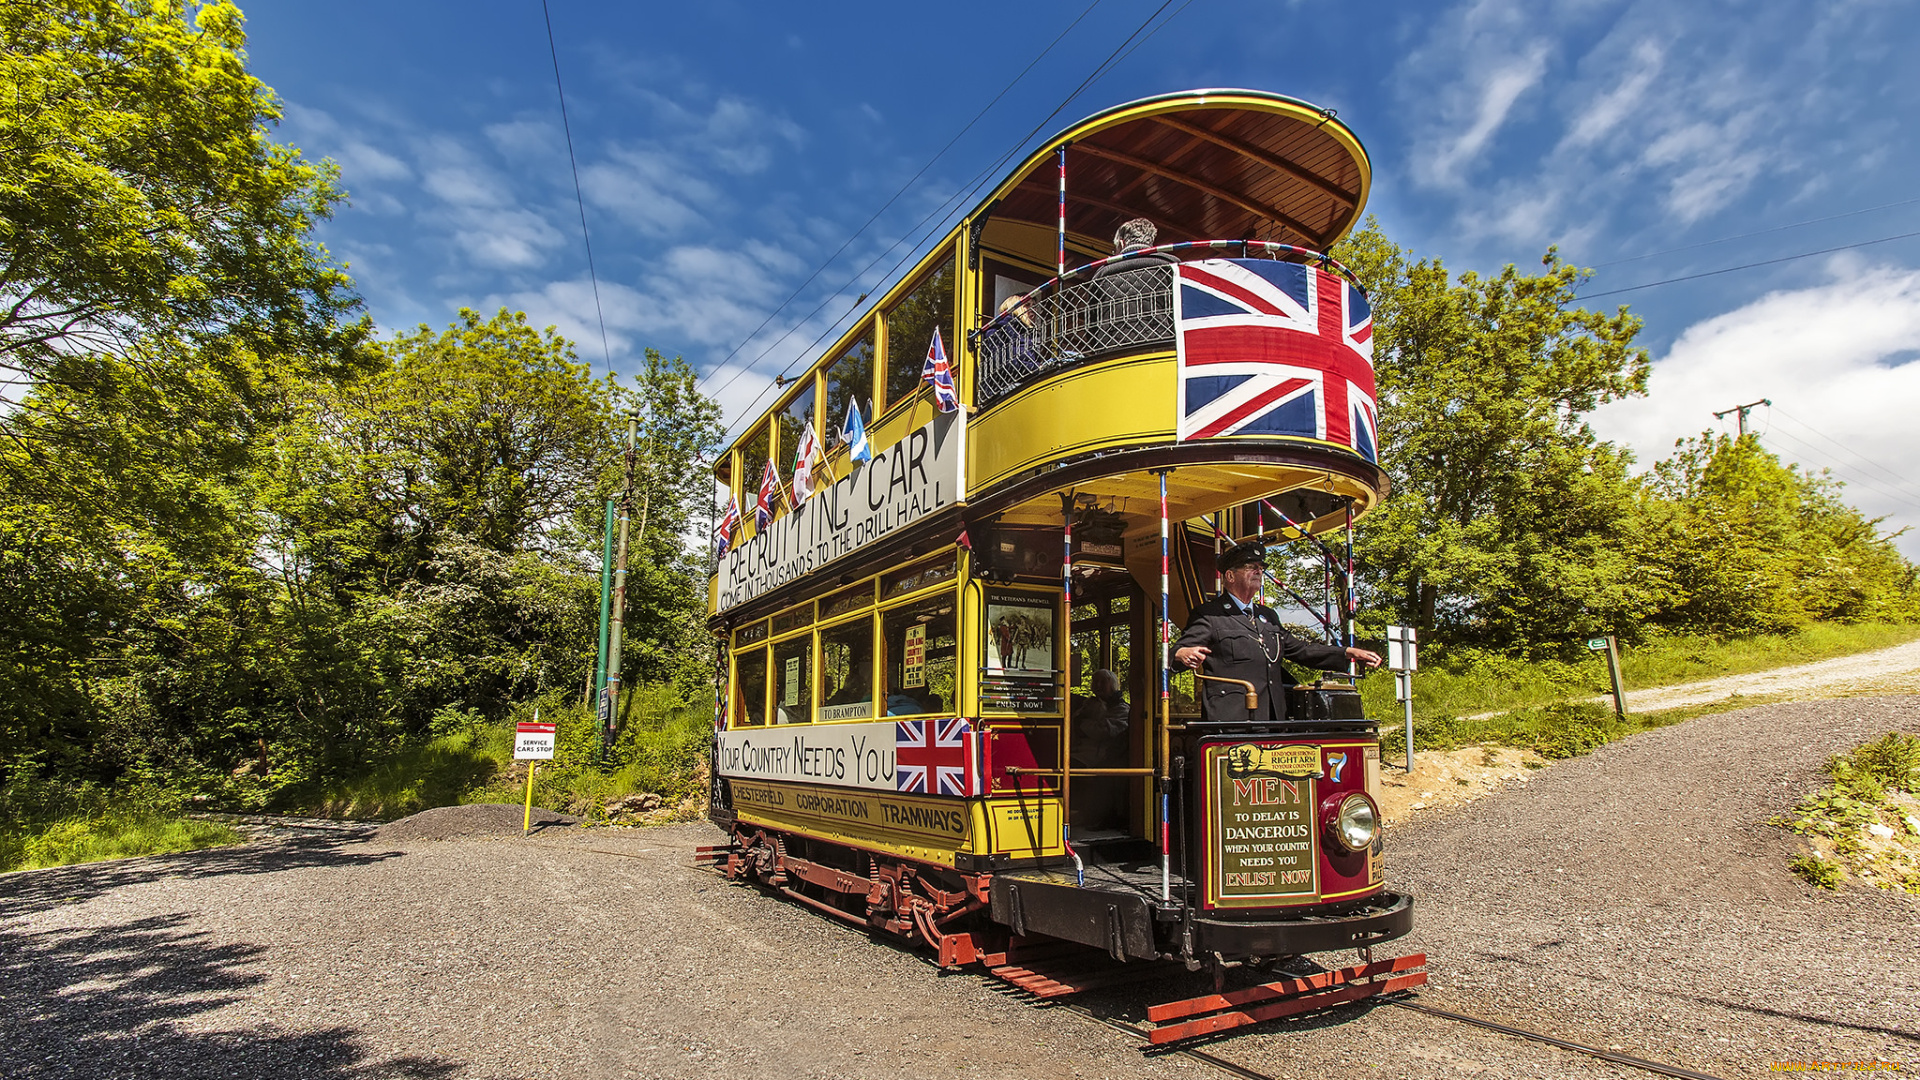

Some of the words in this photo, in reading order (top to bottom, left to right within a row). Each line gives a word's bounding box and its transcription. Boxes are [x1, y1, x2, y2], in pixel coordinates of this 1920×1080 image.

[729, 473, 850, 589] RECRUITING
[868, 426, 928, 512] CAR
[720, 586, 742, 610] COME
[744, 579, 755, 602] IN
[755, 549, 813, 597] THOUSANDS
[817, 541, 829, 565] TO
[832, 527, 852, 557] THE
[856, 508, 893, 546] DRILL
[897, 481, 945, 526] HALL
[824, 709, 832, 719] TO
[833, 705, 867, 718] BRAMPTON
[1023, 701, 1043, 709] NOW!
[794, 736, 845, 780] NEEDS
[851, 735, 895, 784] YOU
[1271, 756, 1298, 764] RIGHT
[1326, 752, 1348, 783] 7
[1233, 777, 1300, 806] MEN
[733, 785, 785, 806] CHESTERFIELD
[796, 792, 869, 819] CORPORATION
[881, 803, 964, 834] TRAMWAYS
[1235, 813, 1250, 822] TO
[1252, 811, 1287, 821] DELAY
[1289, 811, 1300, 820] IS
[1226, 824, 1309, 840] DANGEROUS
[1225, 844, 1250, 854] WHEN
[1251, 843, 1274, 853] YOUR
[1275, 842, 1310, 852] COUNTRY
[1239, 858, 1274, 867] NEEDS
[1278, 856, 1298, 866] YOU
[1225, 871, 1276, 887] ENLIST
[1281, 870, 1311, 885] NOW
